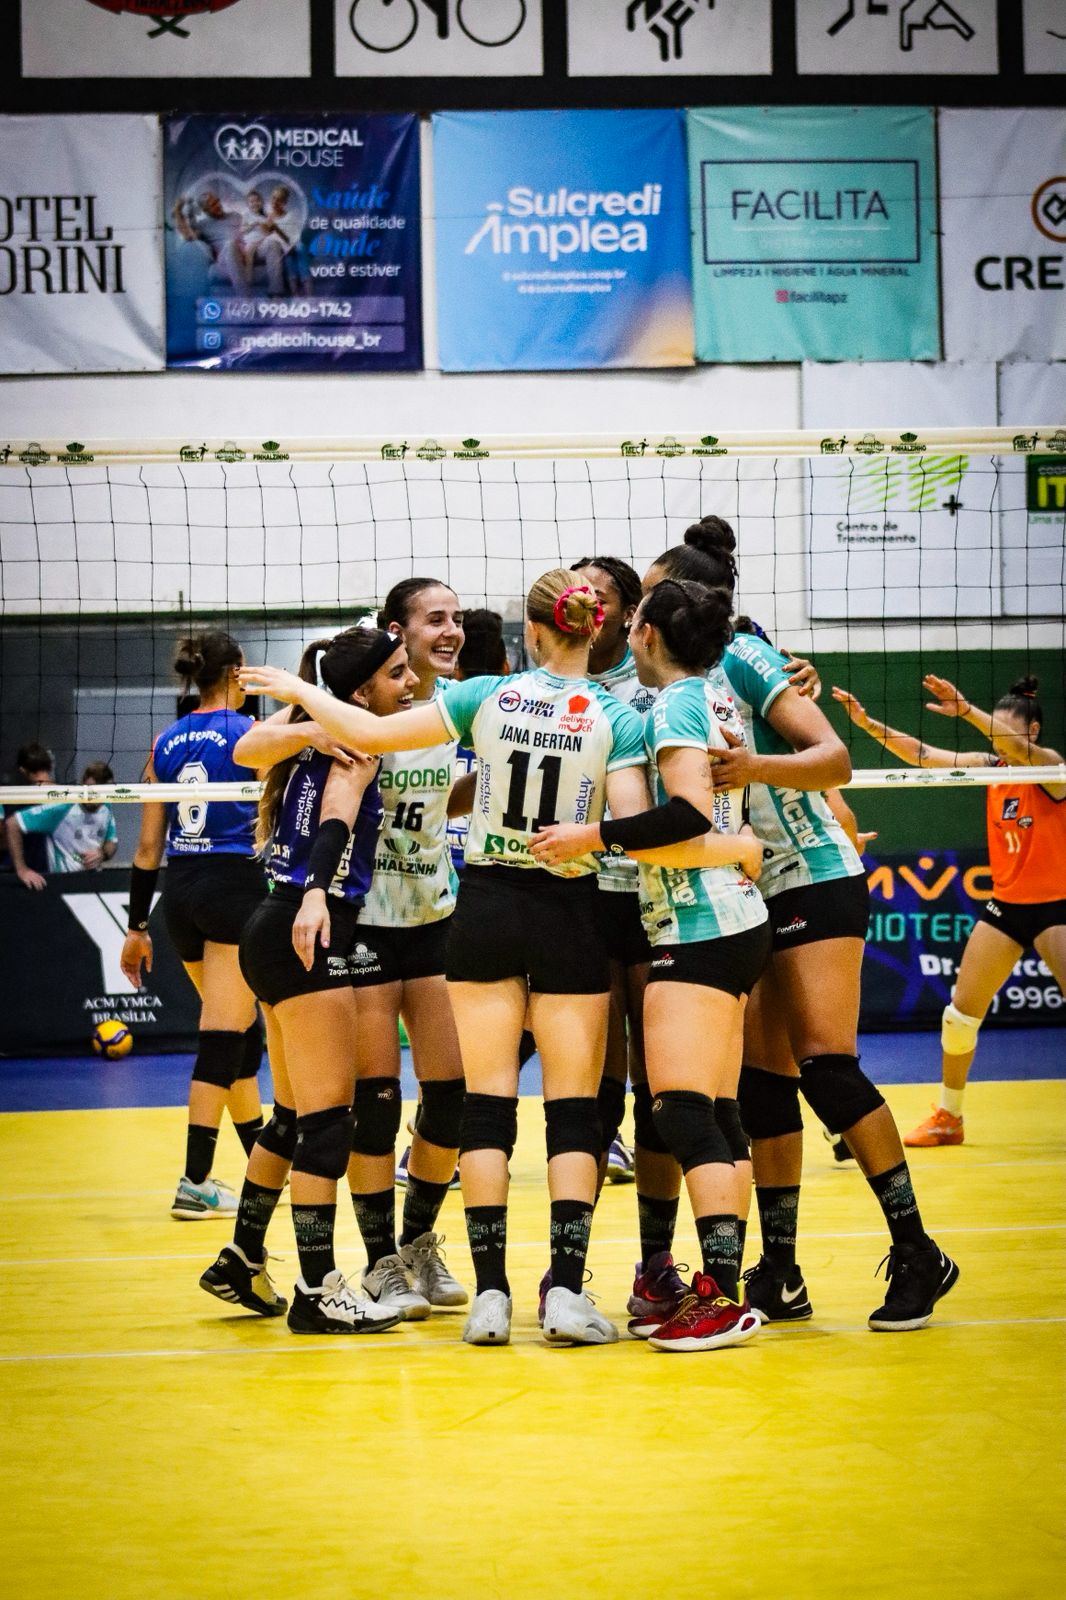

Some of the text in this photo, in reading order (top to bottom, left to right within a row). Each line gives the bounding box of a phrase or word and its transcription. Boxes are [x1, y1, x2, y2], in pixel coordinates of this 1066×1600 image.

[274, 129, 364, 147] MEDICAL
[275, 149, 344, 167] HOUSE
[507, 183, 662, 217] Sulcredi
[732, 189, 890, 220] FACILITA
[309, 215, 406, 232] de qualidade
[308, 231, 381, 257] Onde
[309, 263, 401, 277] você estiver
[974, 256, 1065, 291] CRE
[258, 302, 353, 318] 99840-1742
[560, 714, 596, 727] delivery
[499, 724, 583, 753] JANA BERTAN
[502, 749, 562, 834] 11
[300, 788, 317, 838] Sulcredi
[391, 802, 425, 832] 16
